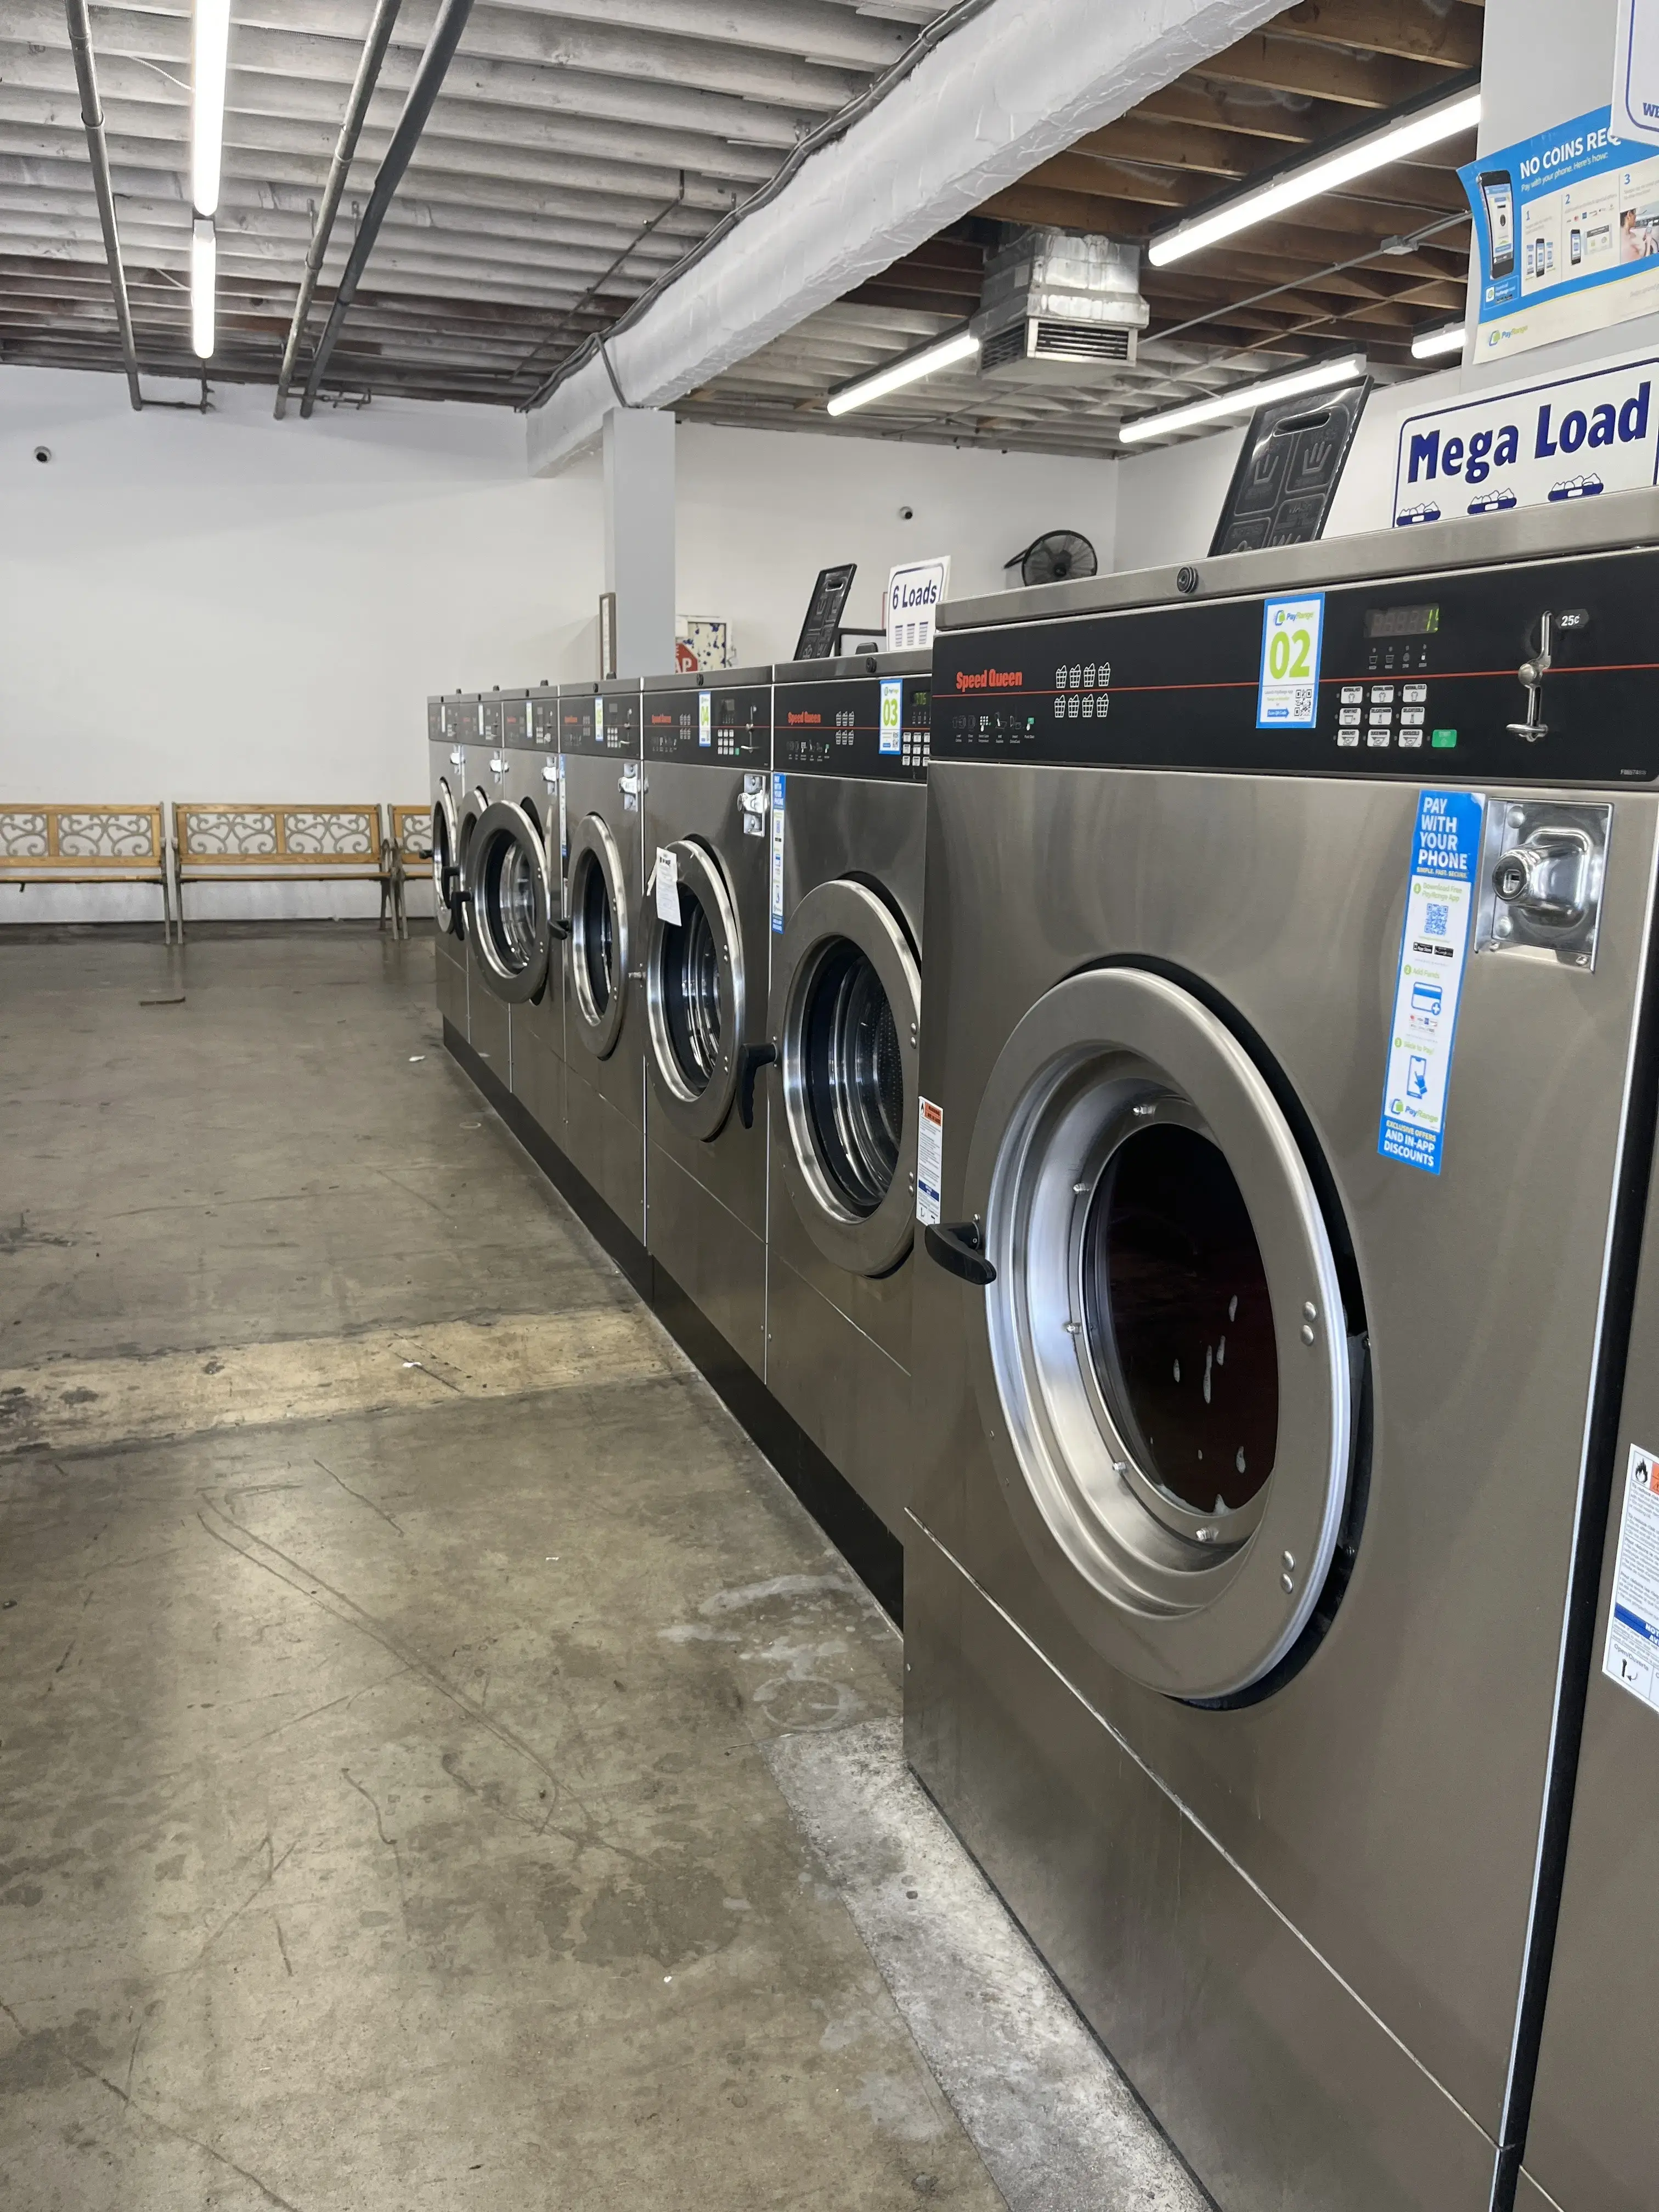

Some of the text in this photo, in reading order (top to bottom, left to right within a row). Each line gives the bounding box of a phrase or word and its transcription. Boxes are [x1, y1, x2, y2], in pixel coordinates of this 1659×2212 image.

[1520, 156, 1540, 179] NO
[1543, 137, 1583, 169] COINS
[1531, 178, 1542, 188] with
[1542, 173, 1553, 184] your
[1624, 174, 1630, 184] 3
[1565, 194, 1570, 204] 2
[1526, 210, 1530, 221] 1
[1407, 381, 1651, 484] Mega Load
[893, 579, 937, 610] 6 Loads
[1286, 611, 1315, 622] PayRange
[1561, 614, 1581, 627] 25¢
[1269, 629, 1310, 679] 02
[956, 668, 1023, 692] Speed Queen
[883, 698, 898, 726] 03
[1423, 797, 1448, 814] PAY
[1421, 814, 1457, 833] WITH
[1419, 831, 1458, 851] YOUR
[1418, 849, 1468, 870] PHONE
[1422, 890, 1459, 902] PayRange App
[1423, 882, 1462, 894] Download Free
[1424, 969, 1440, 979] Funds
[1404, 1105, 1439, 1123] PayRange
[1386, 1119, 1436, 1142] EXCLUSIVE OFFERS
[1385, 1128, 1435, 1153] AND IN-APP
[1383, 1140, 1434, 1167] DISCOUNTS
